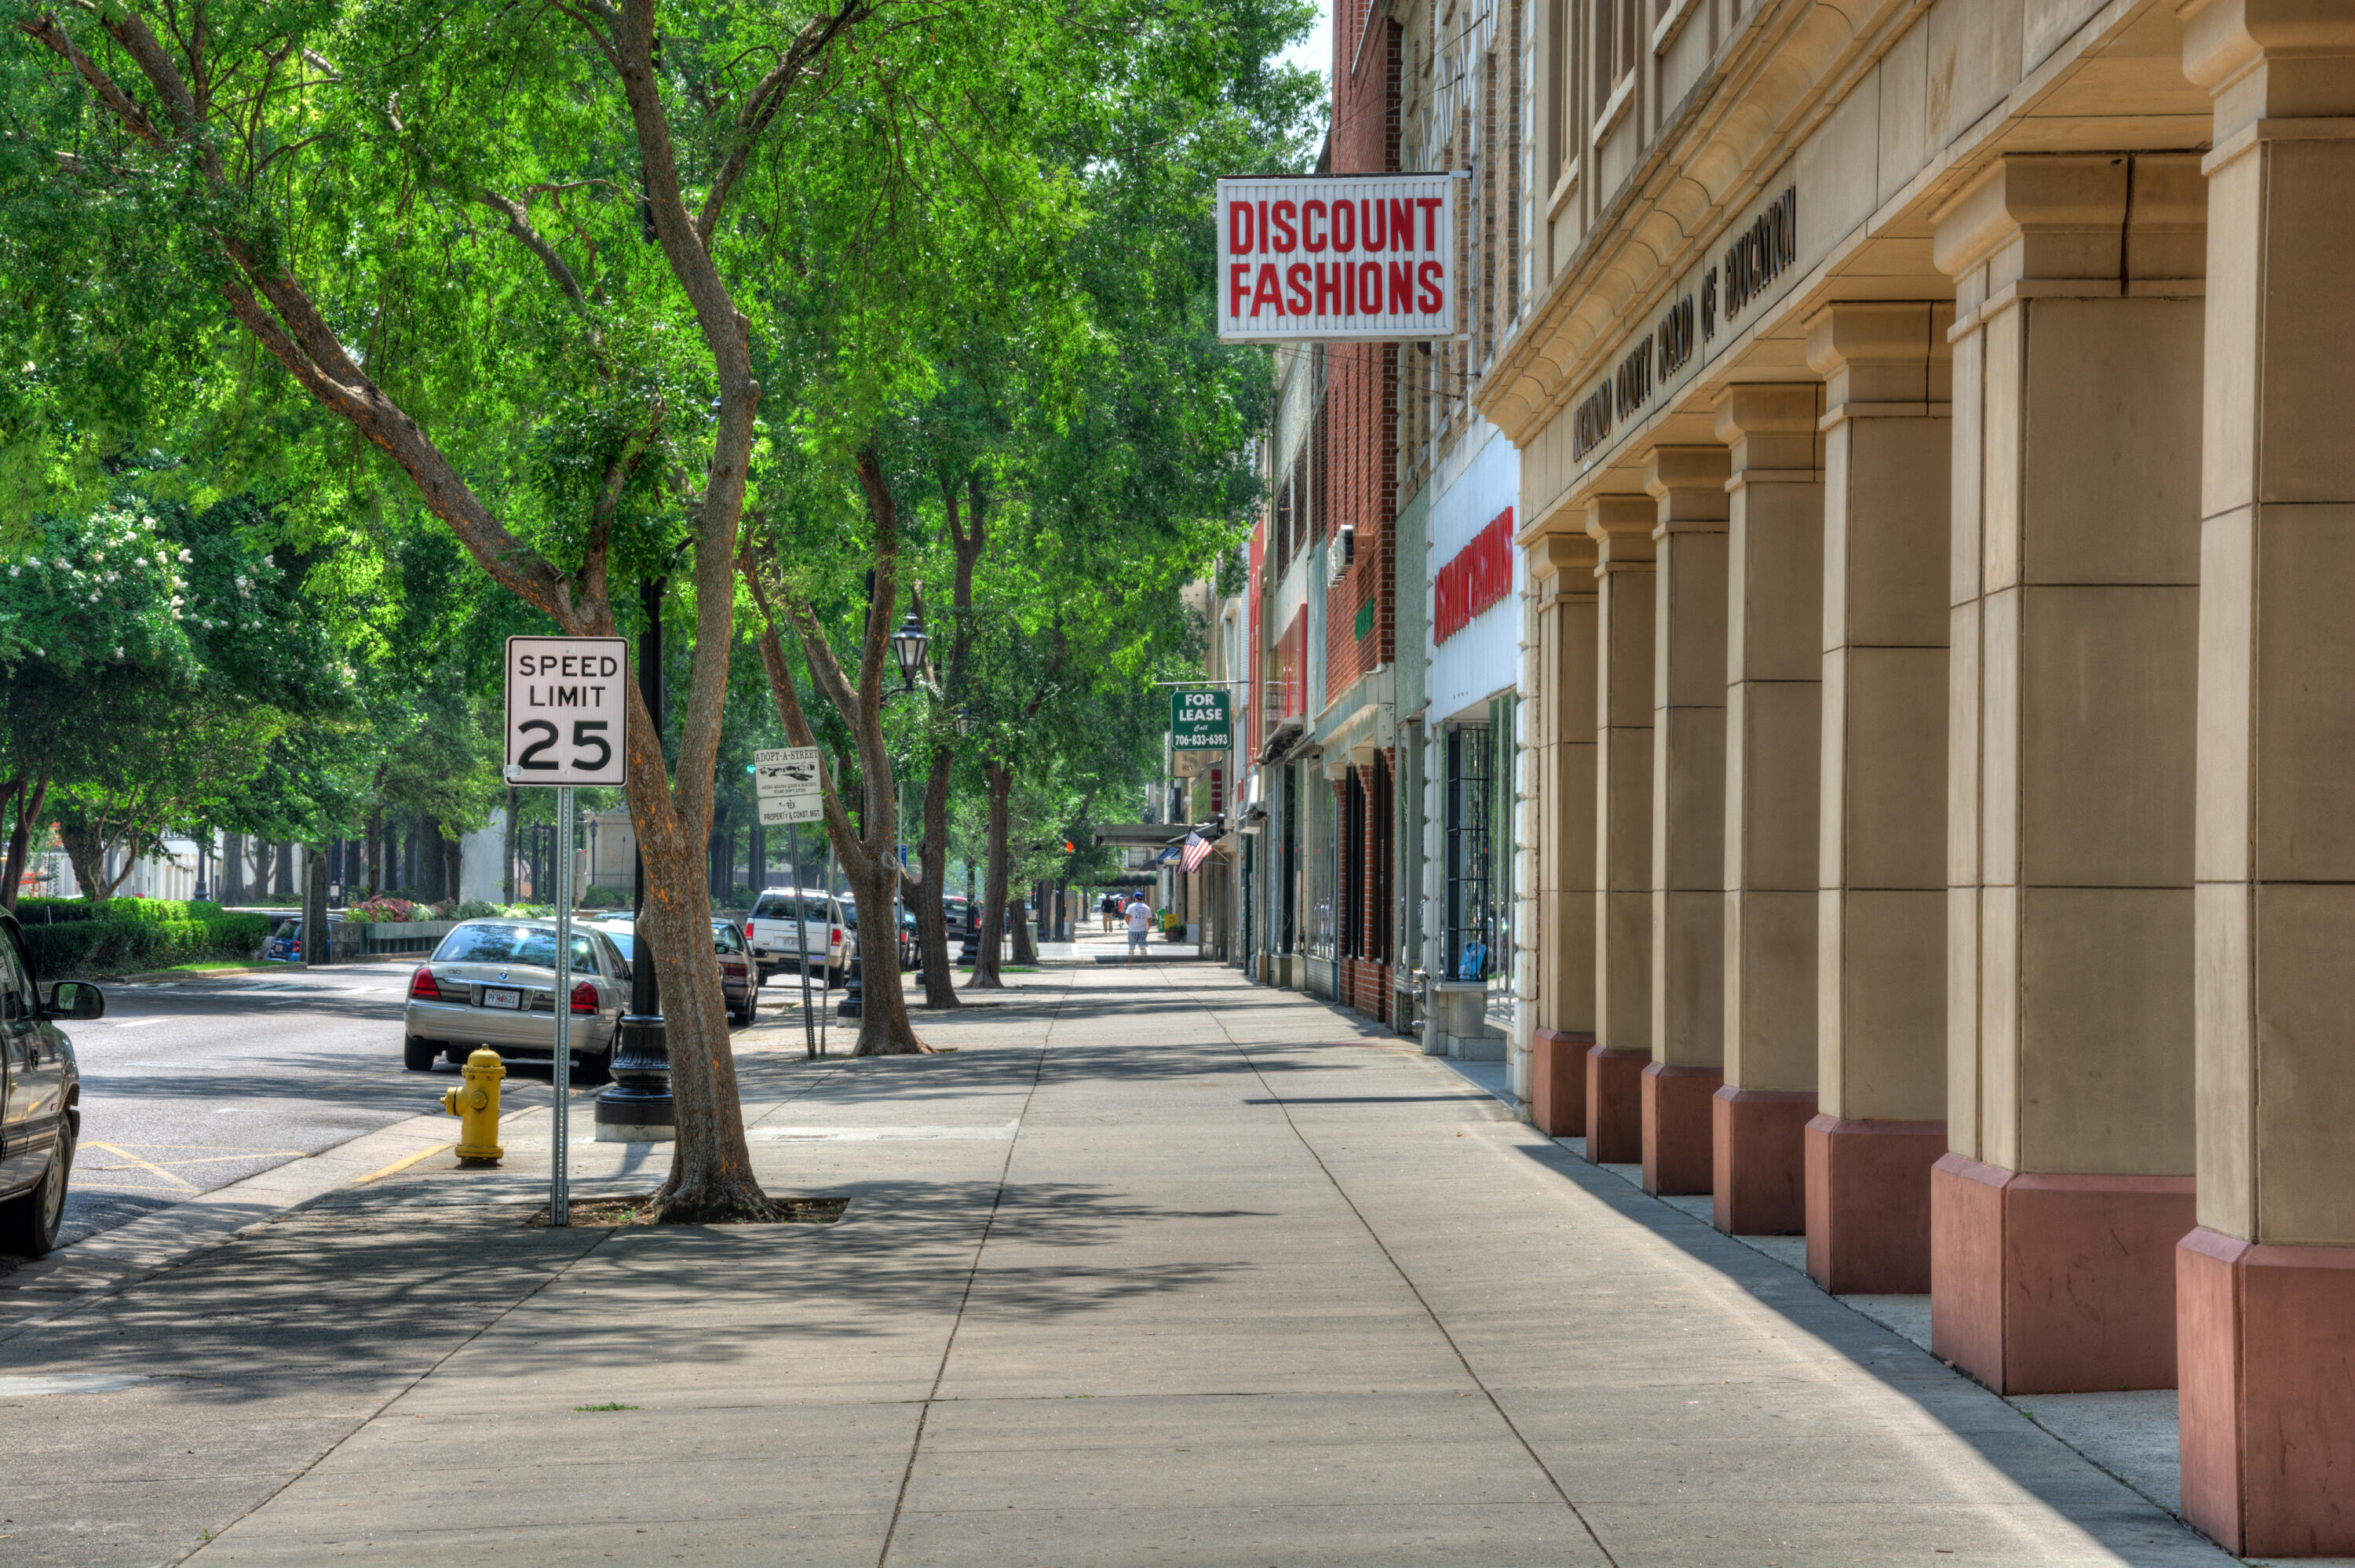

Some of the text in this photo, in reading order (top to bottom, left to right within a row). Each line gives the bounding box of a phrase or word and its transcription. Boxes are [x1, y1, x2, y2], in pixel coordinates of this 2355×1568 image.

[1230, 198, 1442, 254] DISCOUNT
[1725, 183, 1795, 321] EDUCATION
[1231, 261, 1443, 317] FASHIONS
[520, 655, 617, 677] SPEED
[530, 686, 605, 706] LIMIT
[1185, 694, 1215, 706] FOR
[1179, 709, 1222, 721] LEASE
[517, 720, 612, 771] 25
[1175, 734, 1228, 746] 706-833-6393
[756, 749, 817, 762] ADOPT-A-STREET
[764, 812, 788, 821] PROPERTY
